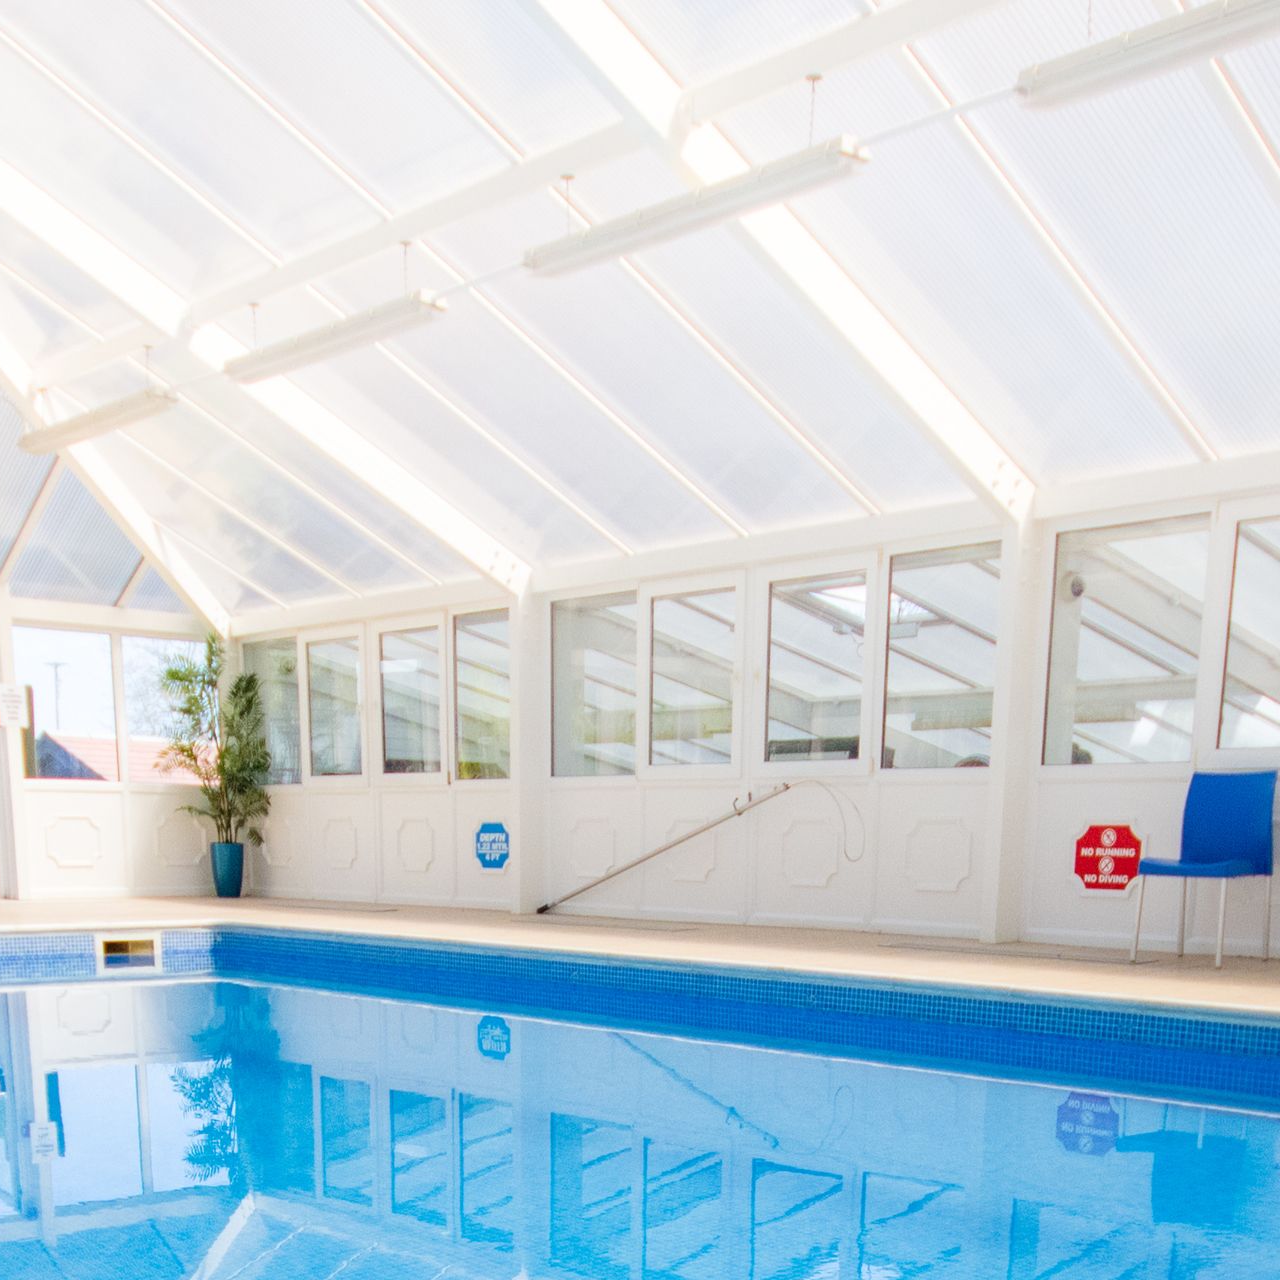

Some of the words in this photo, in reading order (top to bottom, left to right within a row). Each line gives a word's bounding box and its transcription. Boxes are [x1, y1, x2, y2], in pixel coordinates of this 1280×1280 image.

[1081, 847, 1094, 857] NO
[1095, 847, 1136, 858] RUNNING
[1084, 873, 1097, 883] NO
[1098, 874, 1129, 884] DIVING
